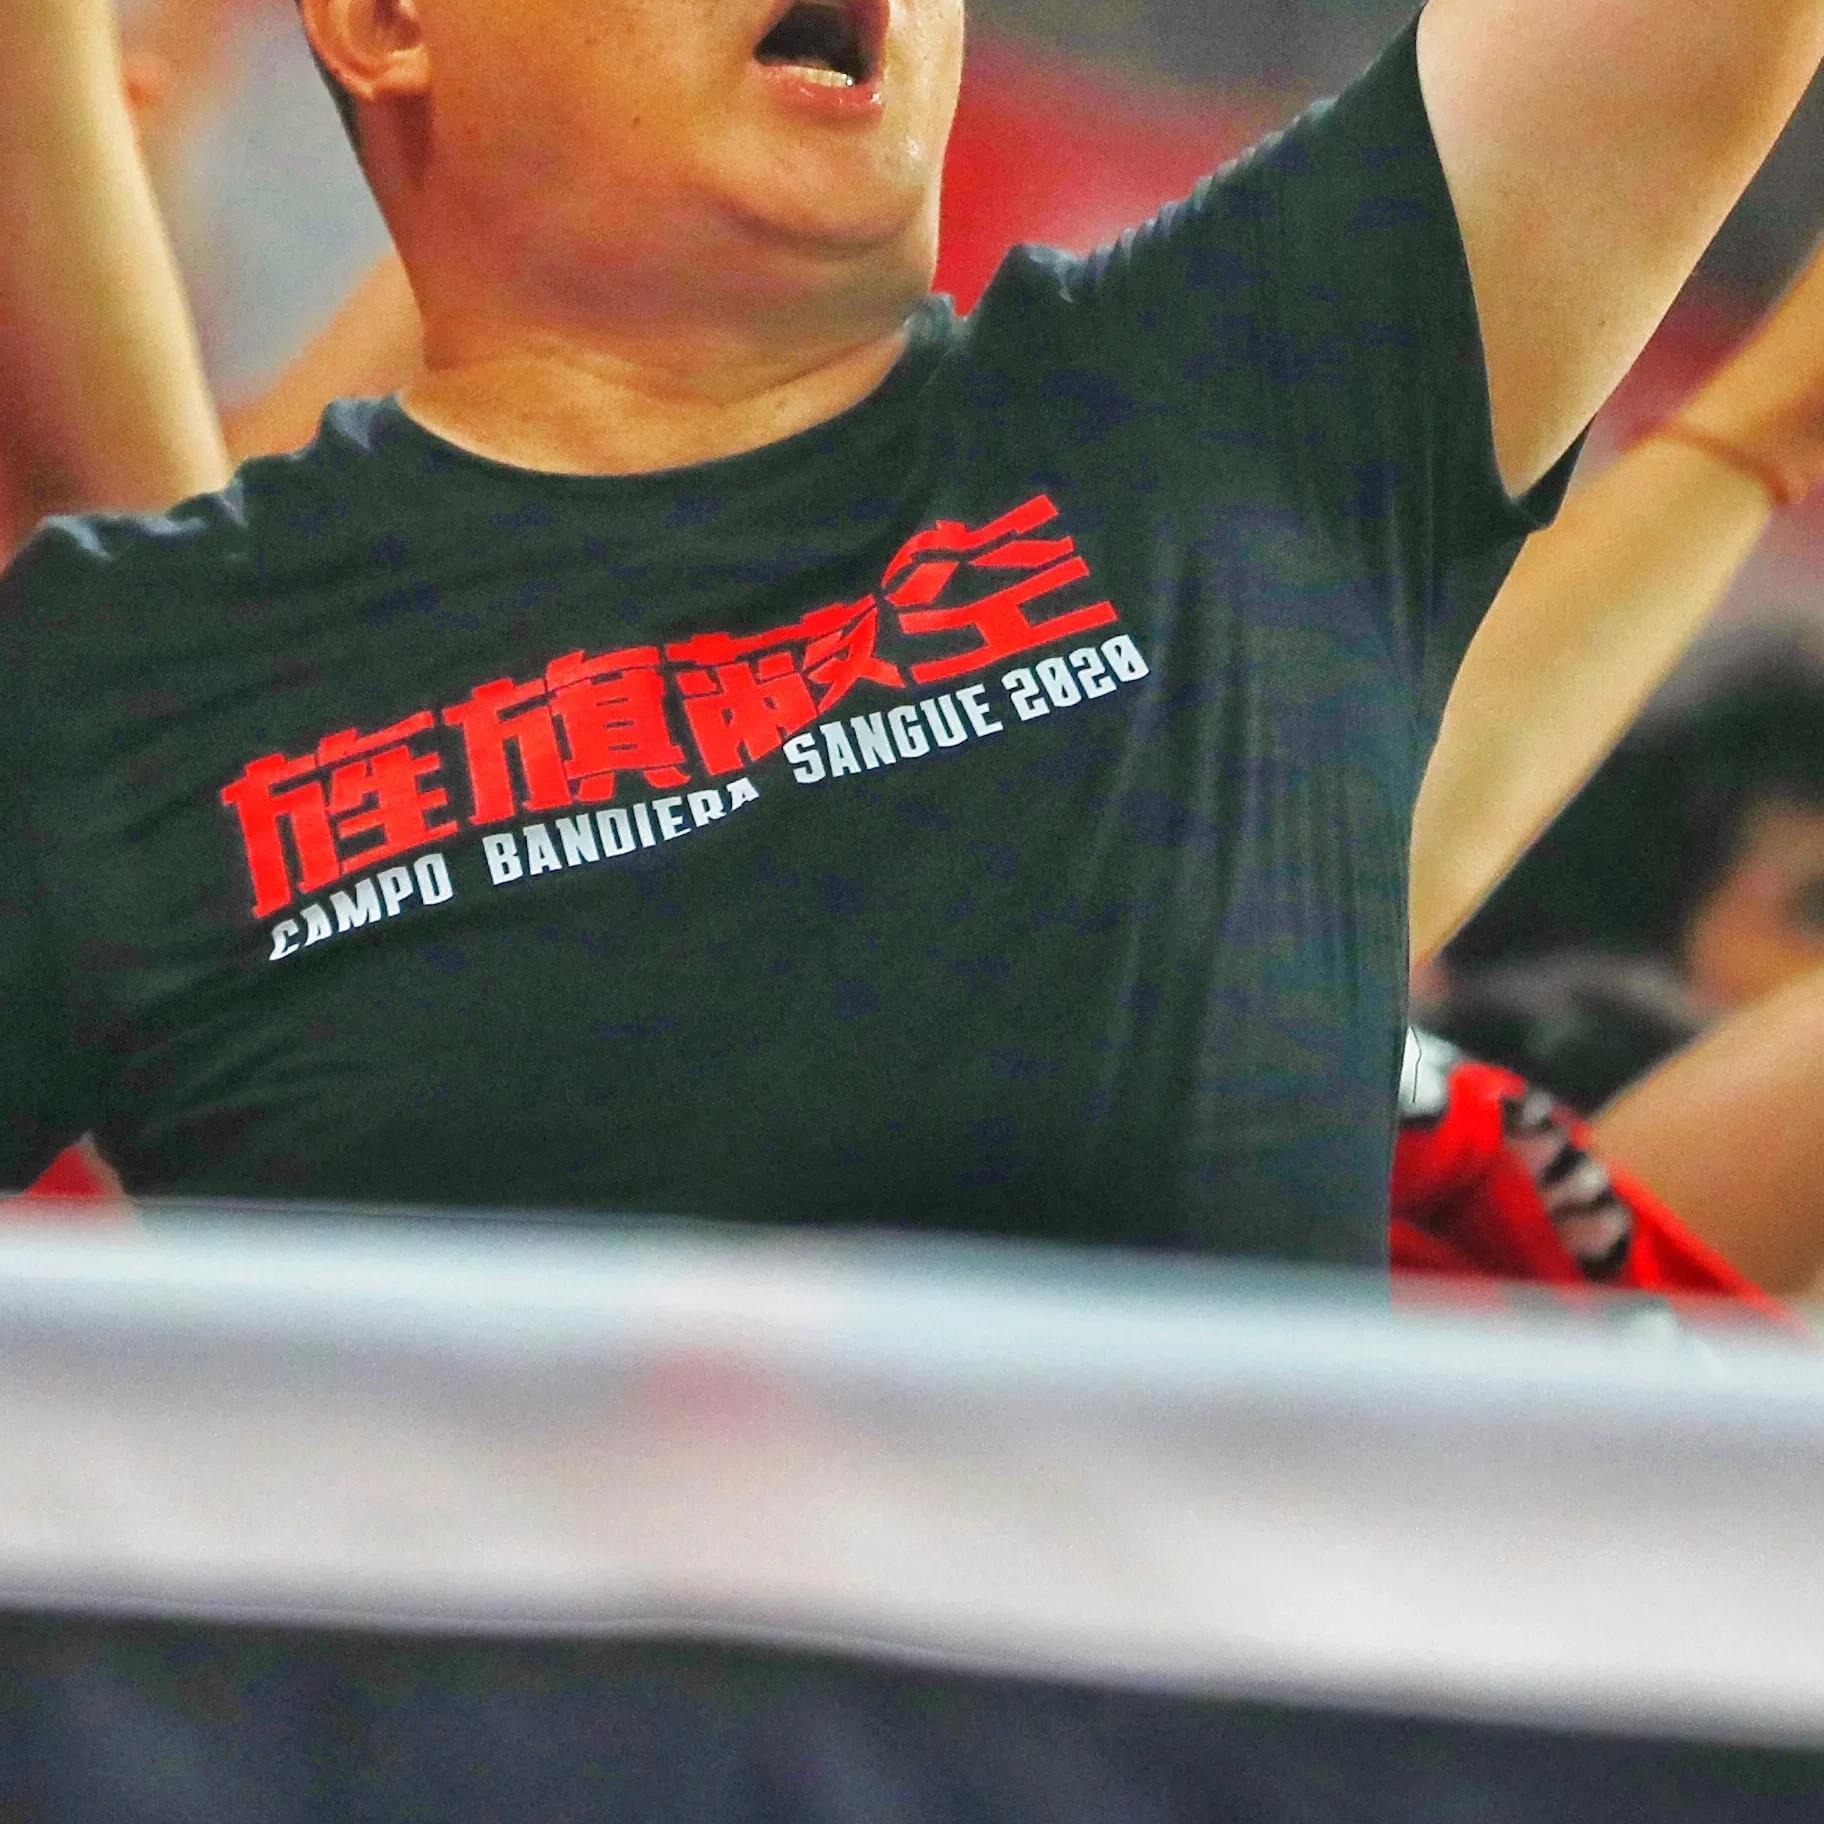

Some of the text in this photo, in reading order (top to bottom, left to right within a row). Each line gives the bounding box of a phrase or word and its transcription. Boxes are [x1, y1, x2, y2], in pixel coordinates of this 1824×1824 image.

[268, 633, 1150, 962] CAMPO BANDIERA SANGUE 2020
